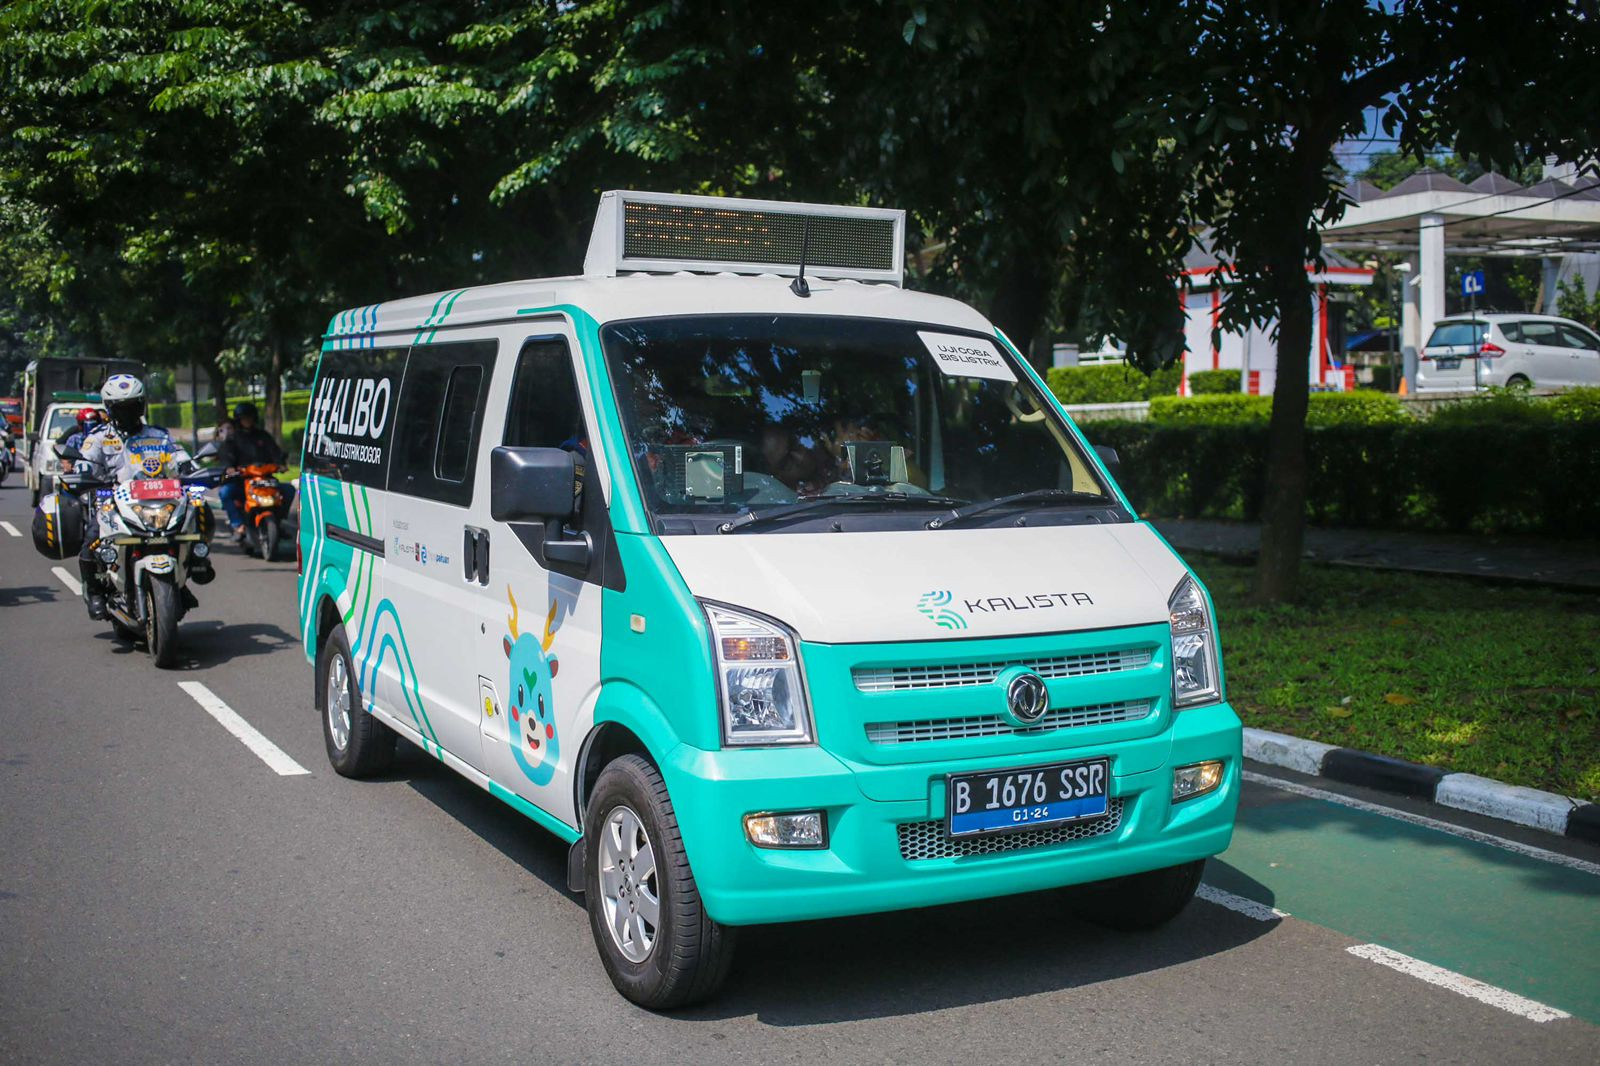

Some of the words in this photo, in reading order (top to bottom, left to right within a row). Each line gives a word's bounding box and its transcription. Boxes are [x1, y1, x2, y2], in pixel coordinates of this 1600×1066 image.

[937, 345, 957, 354] UJI
[957, 347, 992, 358] COBA
[938, 353, 960, 362] BIS
[960, 356, 1002, 367] LISTRIK
[307, 377, 391, 454] #ALIBO
[360, 445, 381, 465] BOGOR
[963, 592, 1094, 613] KALISTA
[956, 781, 971, 814] B
[985, 772, 1047, 810] 1676
[1059, 764, 1104, 800] SSR
